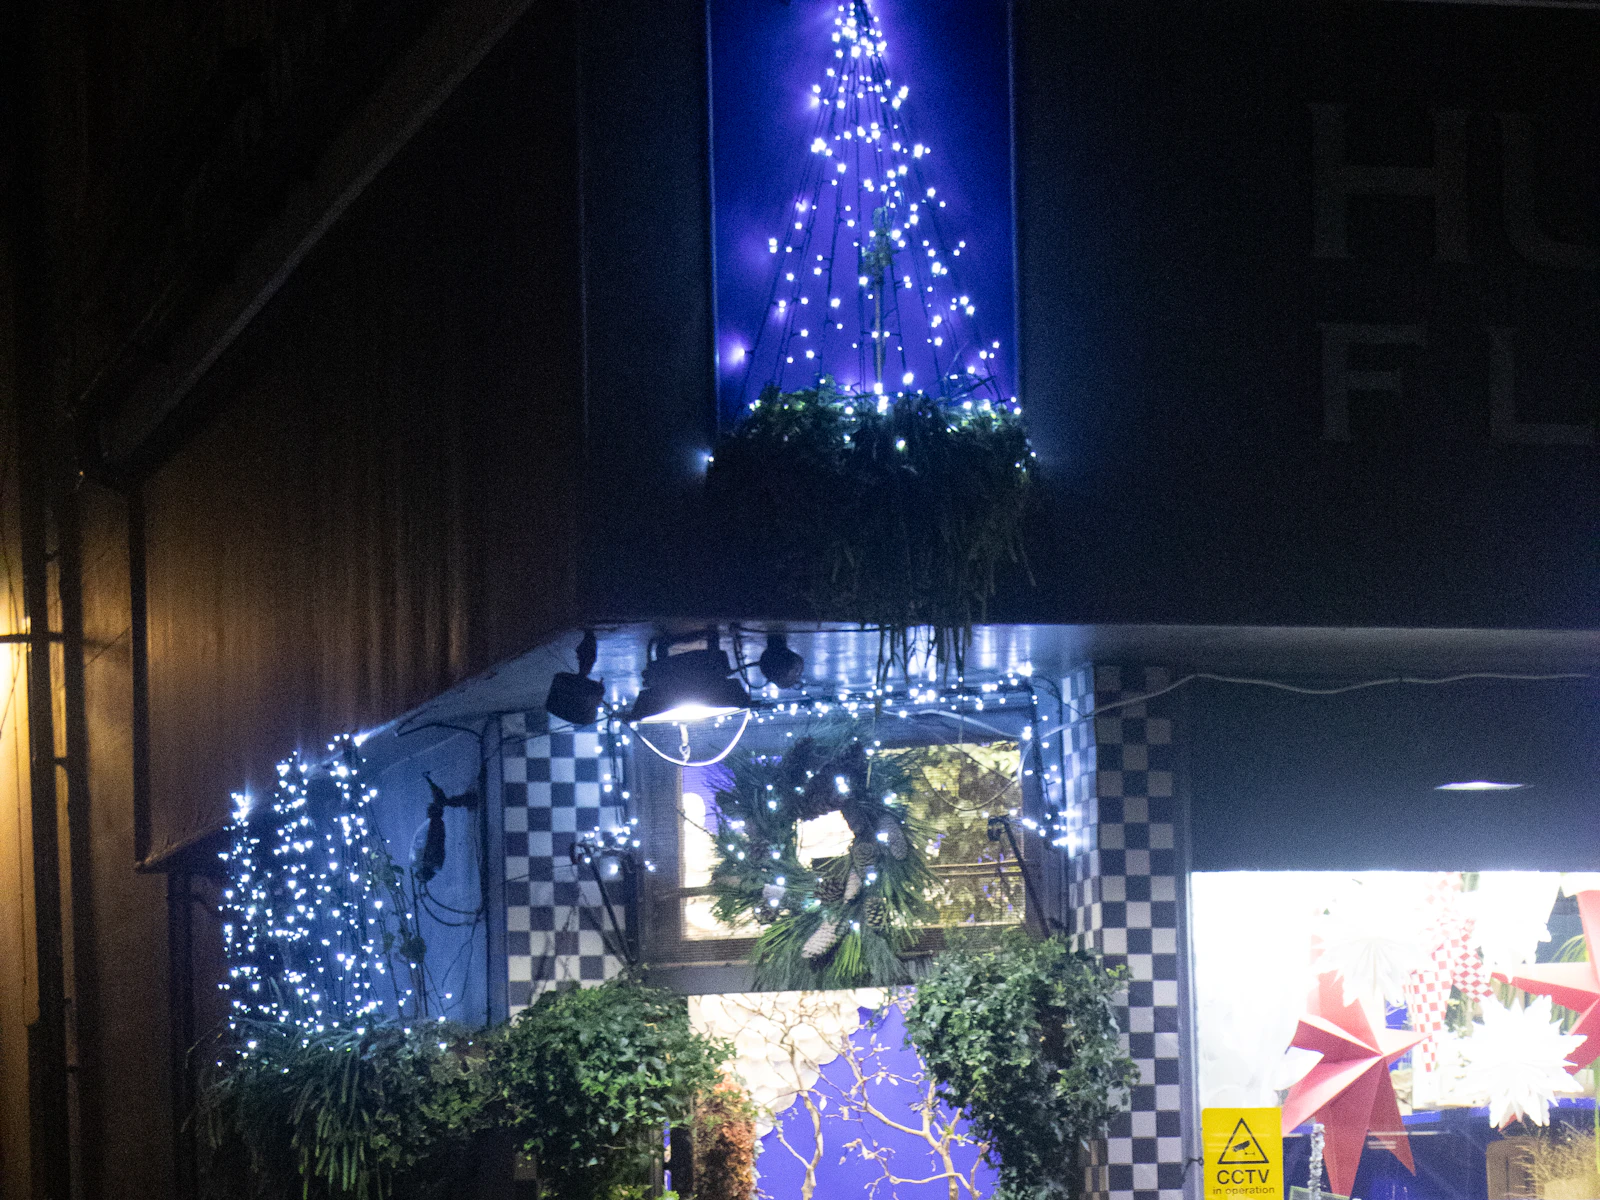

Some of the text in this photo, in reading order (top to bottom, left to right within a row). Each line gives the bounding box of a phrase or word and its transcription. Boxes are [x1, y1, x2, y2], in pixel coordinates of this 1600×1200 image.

[1318, 321, 1594, 445] FL
[1216, 1169, 1270, 1184] CCTV
[1212, 1186, 1275, 1197] in operation
